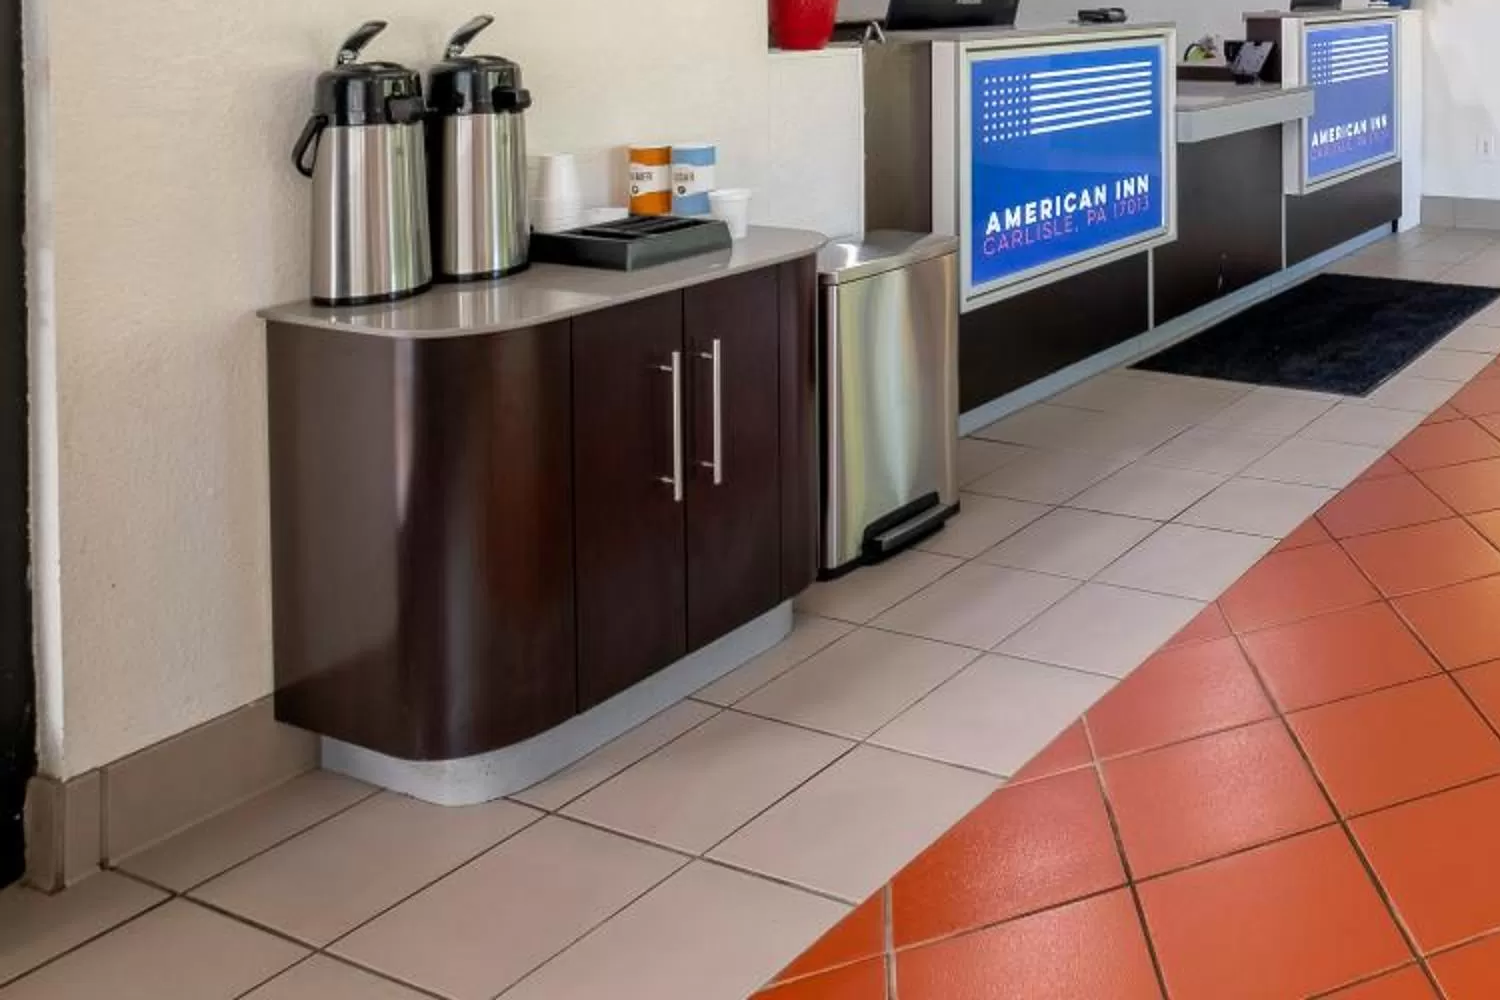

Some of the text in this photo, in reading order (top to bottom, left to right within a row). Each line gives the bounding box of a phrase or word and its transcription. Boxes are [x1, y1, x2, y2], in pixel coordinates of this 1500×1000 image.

[1311, 119, 1367, 148] AMERICAN
[985, 174, 1149, 236] AMERICAN INN
[1087, 207, 1107, 227] PA
